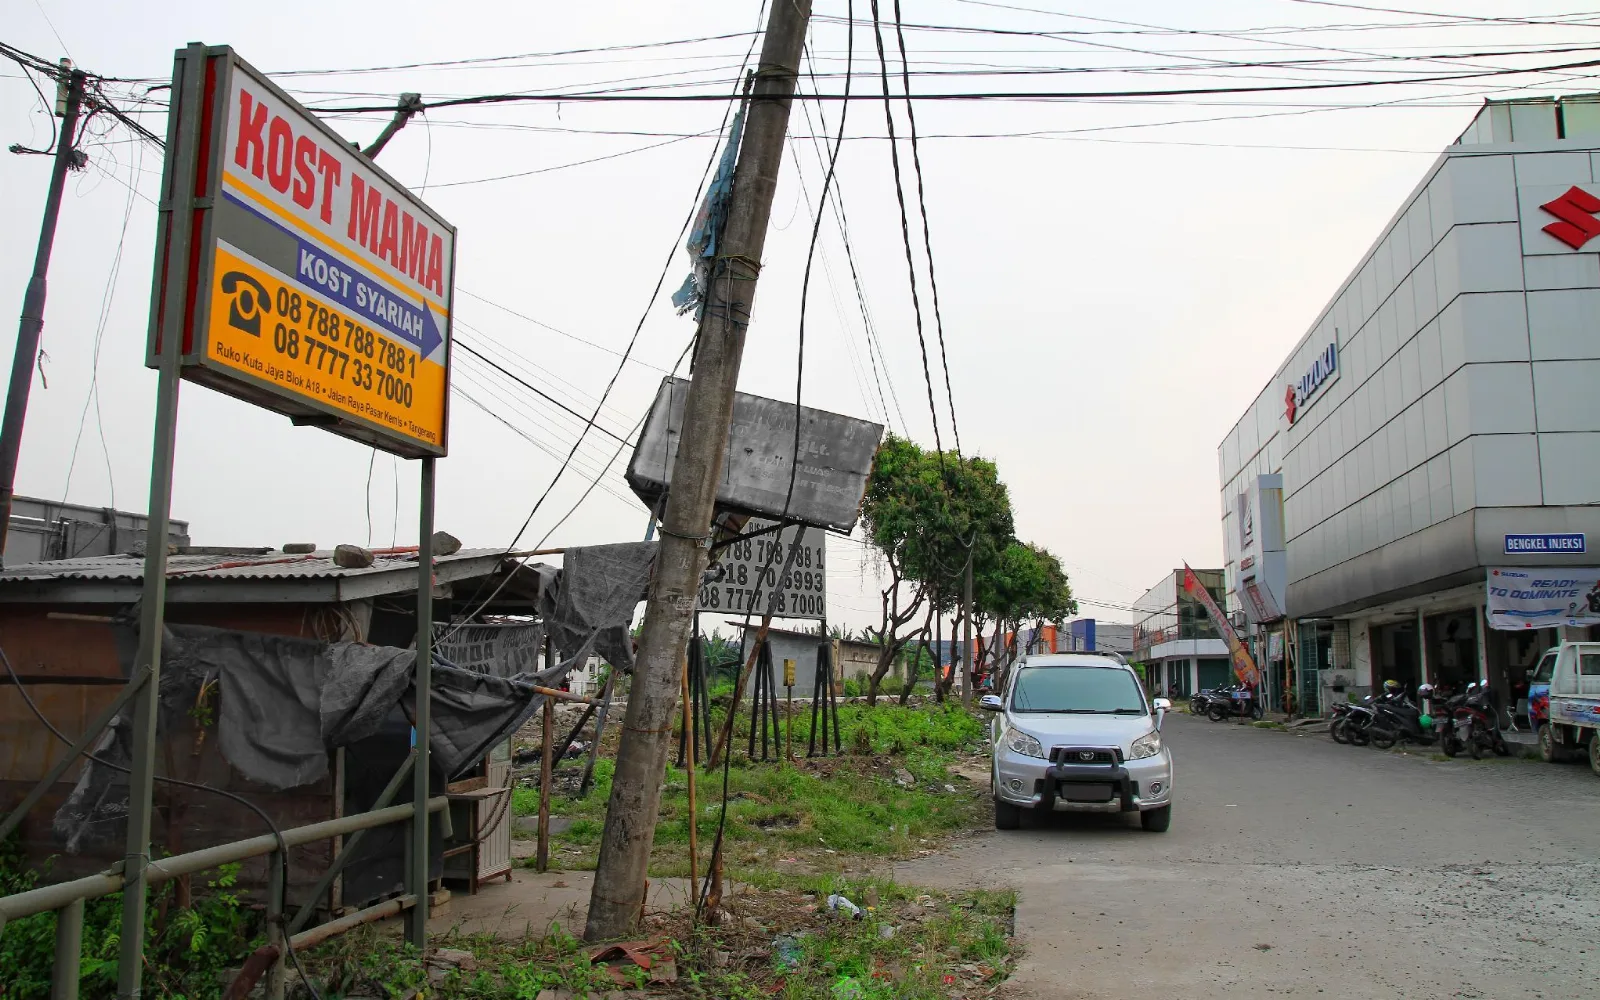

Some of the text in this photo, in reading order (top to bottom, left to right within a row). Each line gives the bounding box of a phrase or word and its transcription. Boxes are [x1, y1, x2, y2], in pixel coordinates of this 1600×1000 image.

[234, 88, 443, 298] KOST MAMA
[300, 249, 424, 340] KOST SYARIAH
[276, 287, 302, 323] 08
[306, 300, 340, 342] 788
[344, 319, 374, 358] 788
[274, 322, 413, 408] 08 7777 33 7000
[1295, 343, 1336, 407] SUZUKI
[216, 341, 436, 442] Ruko Kuta Jaya Blok A18 Jalan Raya Pasar Kemis Tangerang
[816, 547, 824, 569] 1
[1507, 538, 1582, 549] BENGKEL INJEKSI
[700, 585, 720, 608] 08
[791, 593, 823, 615] 7000
[755, 565, 776, 588] 70
[784, 570, 823, 592] 6993
[1490, 586, 1580, 600] TO DOMINATE
[1530, 580, 1578, 588] READY
